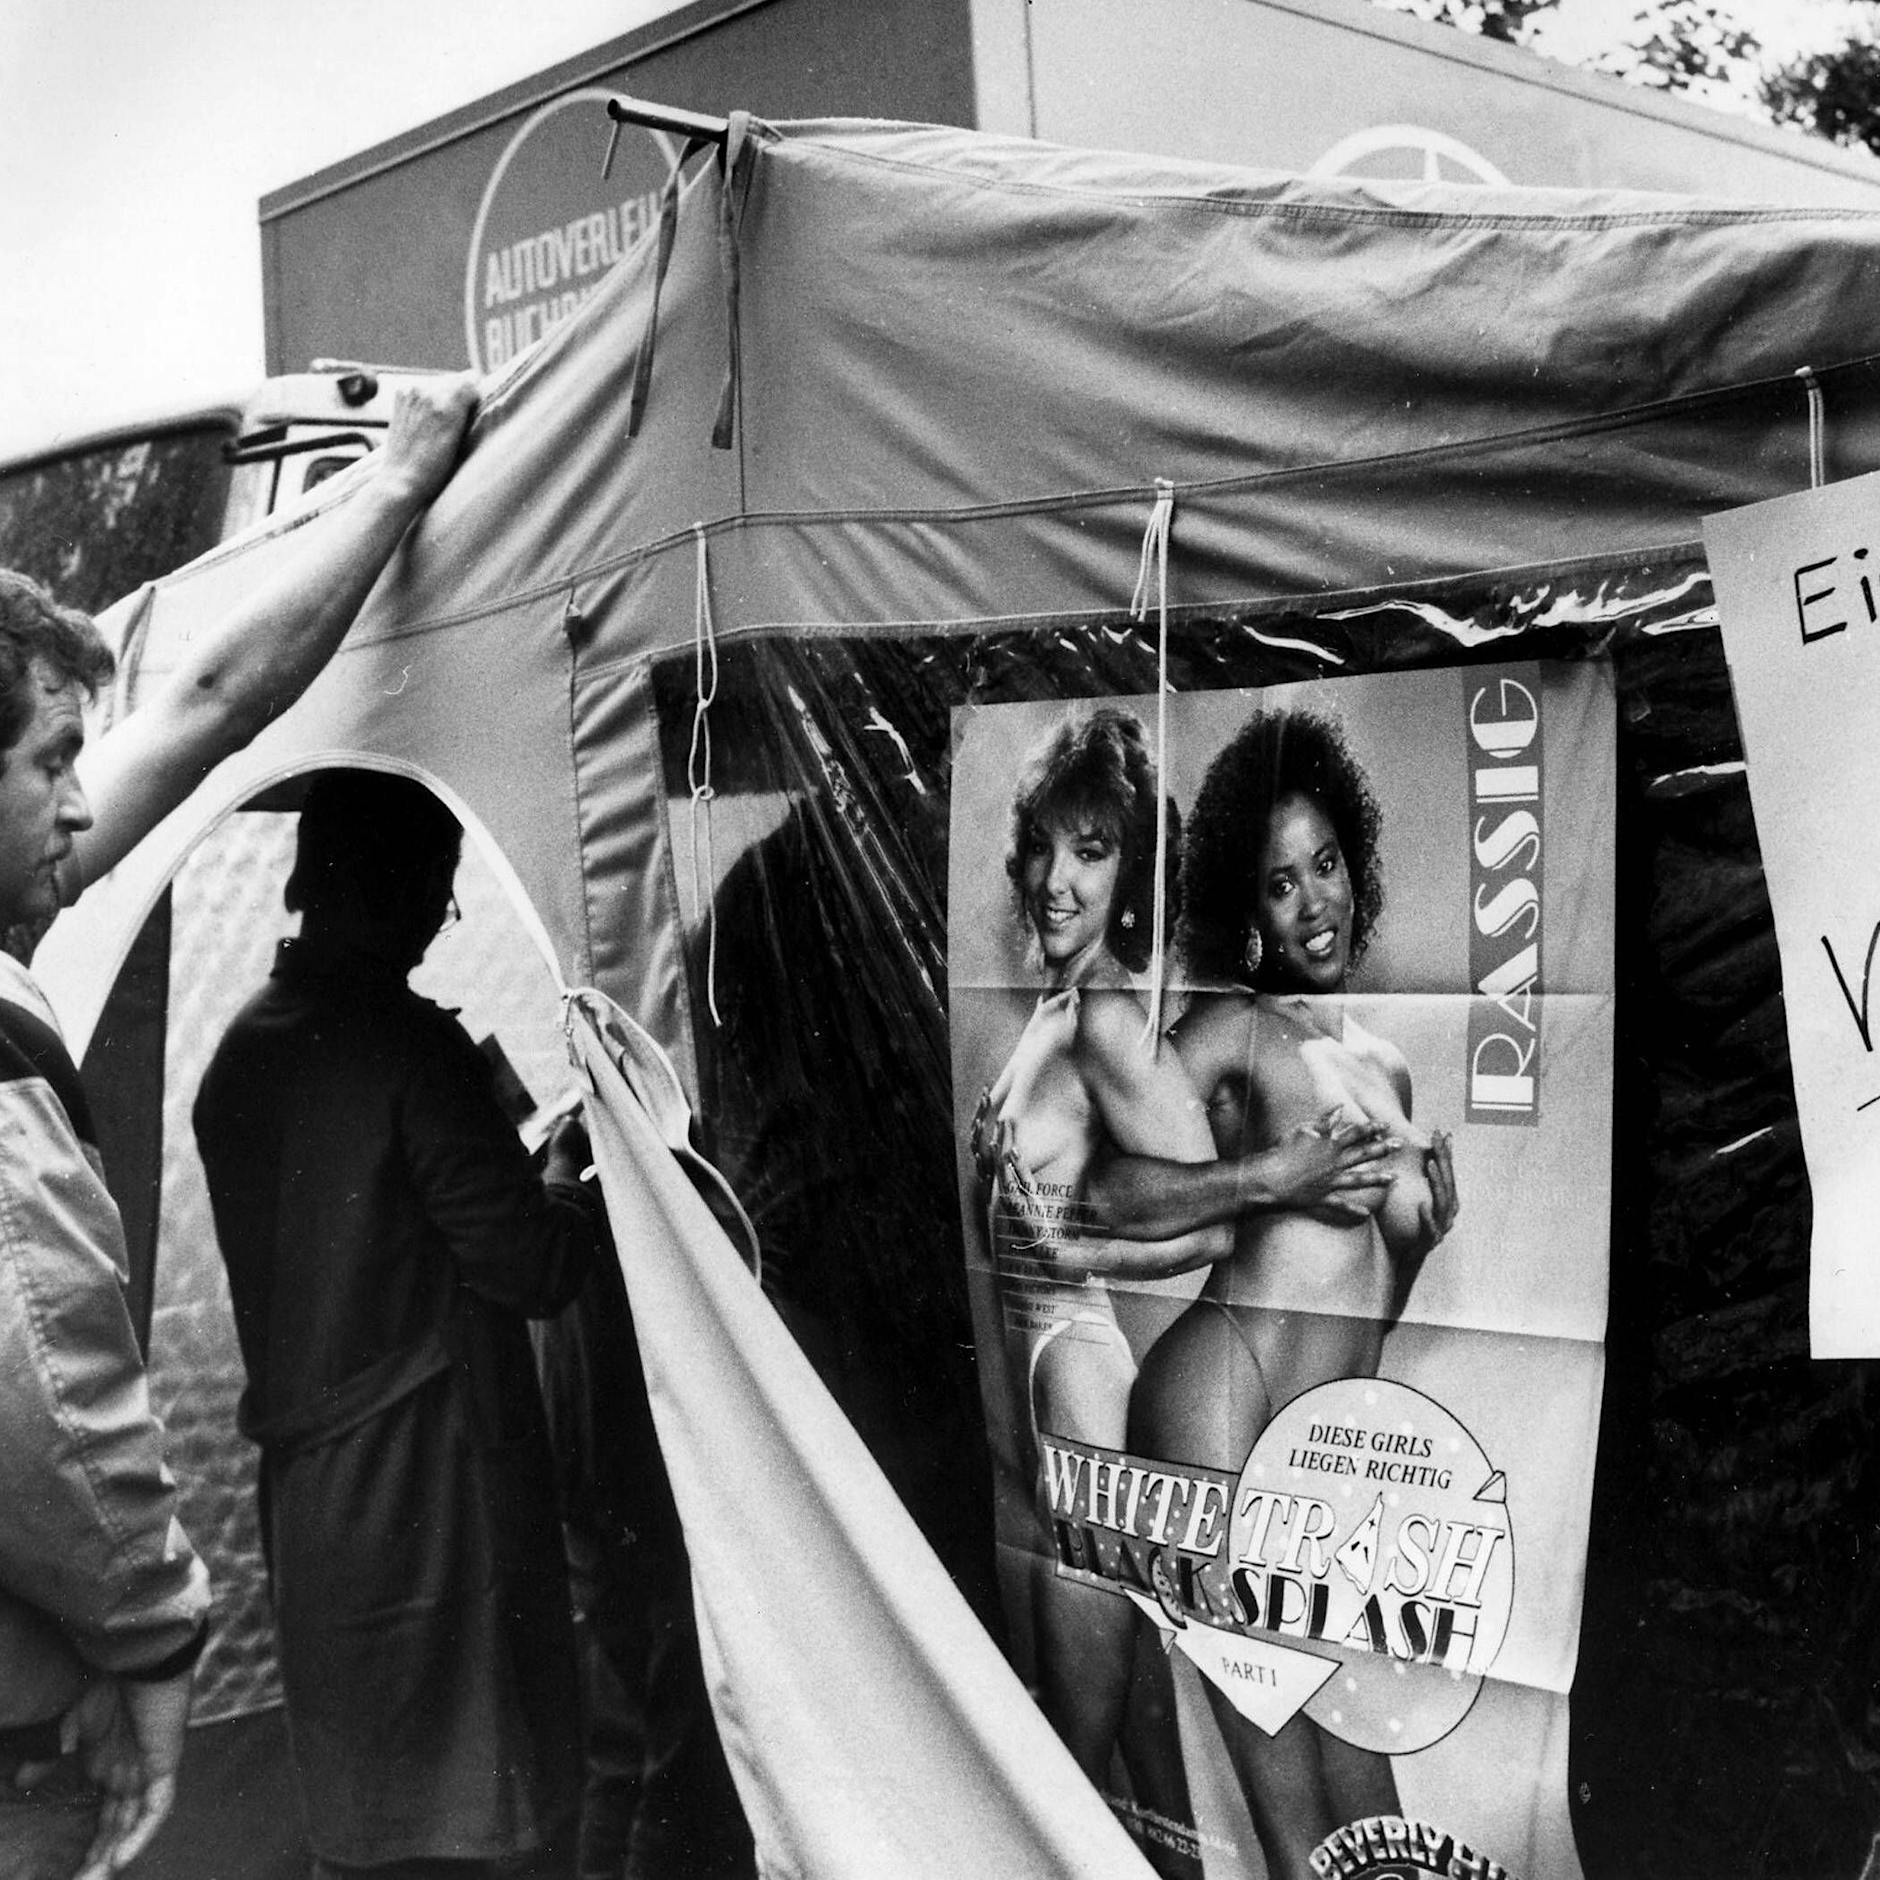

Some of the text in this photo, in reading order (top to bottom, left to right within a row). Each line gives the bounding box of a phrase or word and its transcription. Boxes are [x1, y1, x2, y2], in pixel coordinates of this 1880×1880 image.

[1470, 678, 1541, 1112] RASSIG
[1036, 1182, 1074, 1198] FORCE
[1307, 1423, 1433, 1458] DIESE GIRLS
[1288, 1448, 1453, 1489] LIEGEN RICHTIG
[1043, 1444, 1506, 1609] WHITE TRASH
[1229, 1566, 1480, 1673] SPLASH
[1221, 1656, 1266, 1684] PART
[1308, 1815, 1452, 1880] BEVERLY
